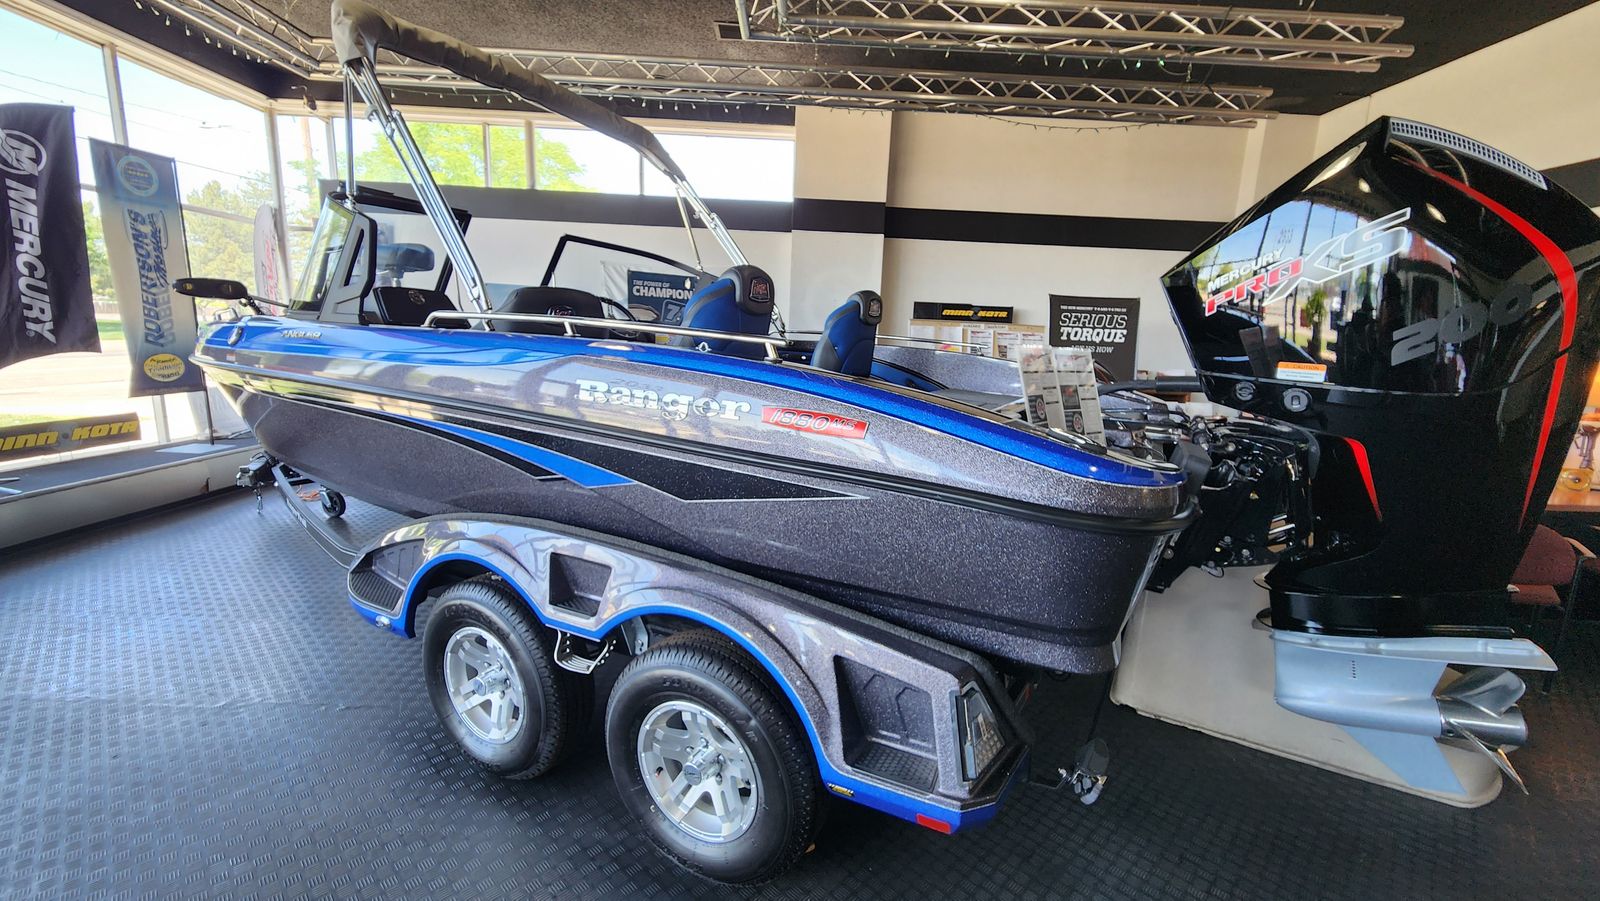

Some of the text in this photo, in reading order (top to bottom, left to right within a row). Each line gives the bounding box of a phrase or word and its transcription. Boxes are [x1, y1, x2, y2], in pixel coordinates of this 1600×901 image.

[5, 178, 56, 344] MERCURY
[1205, 207, 1411, 317] PRO XS
[1208, 247, 1284, 294] MERCURY
[632, 285, 693, 300] CHAMPION
[942, 309, 1008, 318] MINN KOTA
[1060, 312, 1128, 329] SERIOUS
[1060, 326, 1128, 343] TORQUE
[1096, 346, 1114, 354] NOW
[573, 378, 752, 422] Ranger
[769, 408, 858, 431] 1880 MS
[0, 420, 139, 452] INN KOTA
